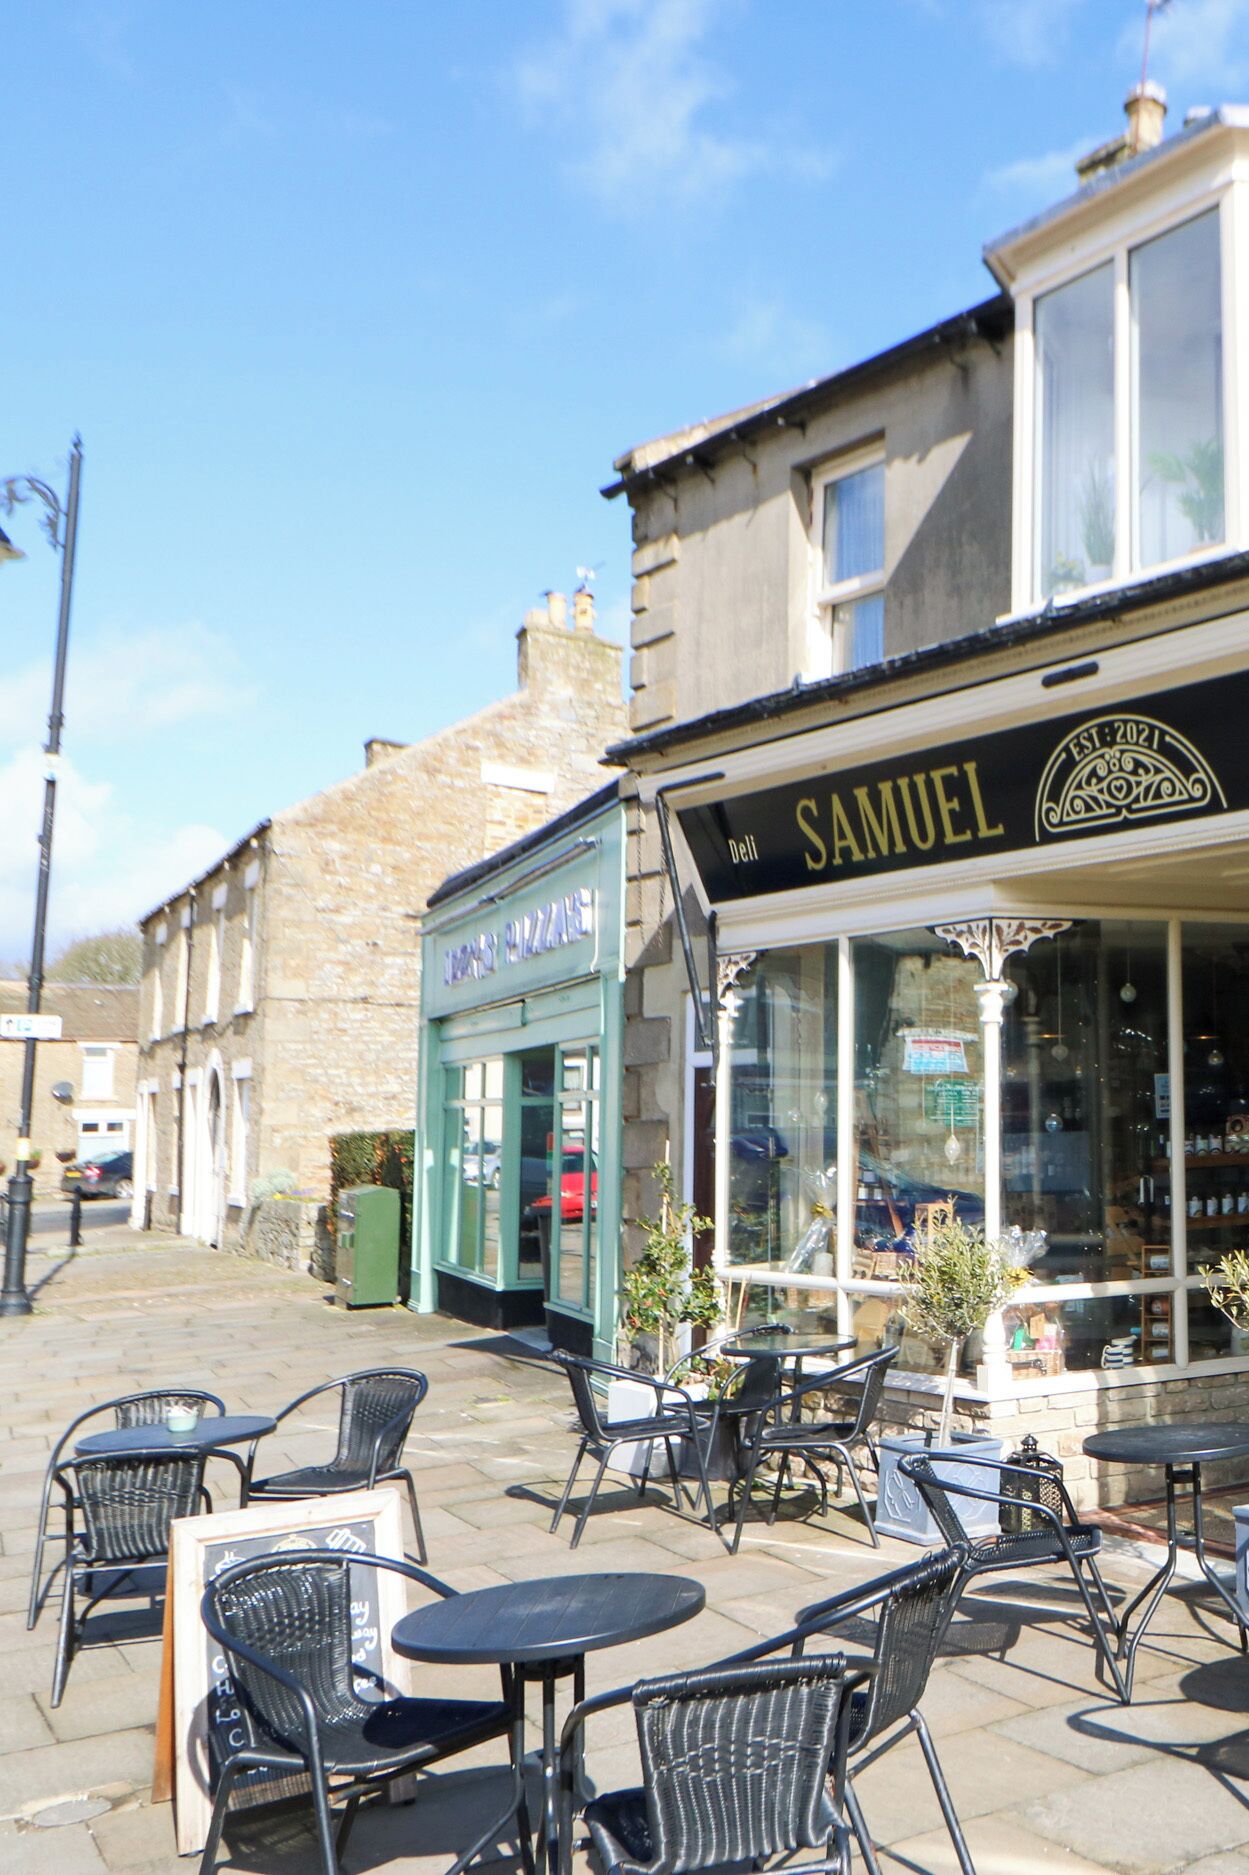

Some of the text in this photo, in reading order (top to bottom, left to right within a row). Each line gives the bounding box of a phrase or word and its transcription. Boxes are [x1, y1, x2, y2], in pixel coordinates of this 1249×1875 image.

[1114, 721, 1159, 750] 2021
[796, 759, 1004, 871] SAMUEL
[728, 834, 759, 864] Deli
